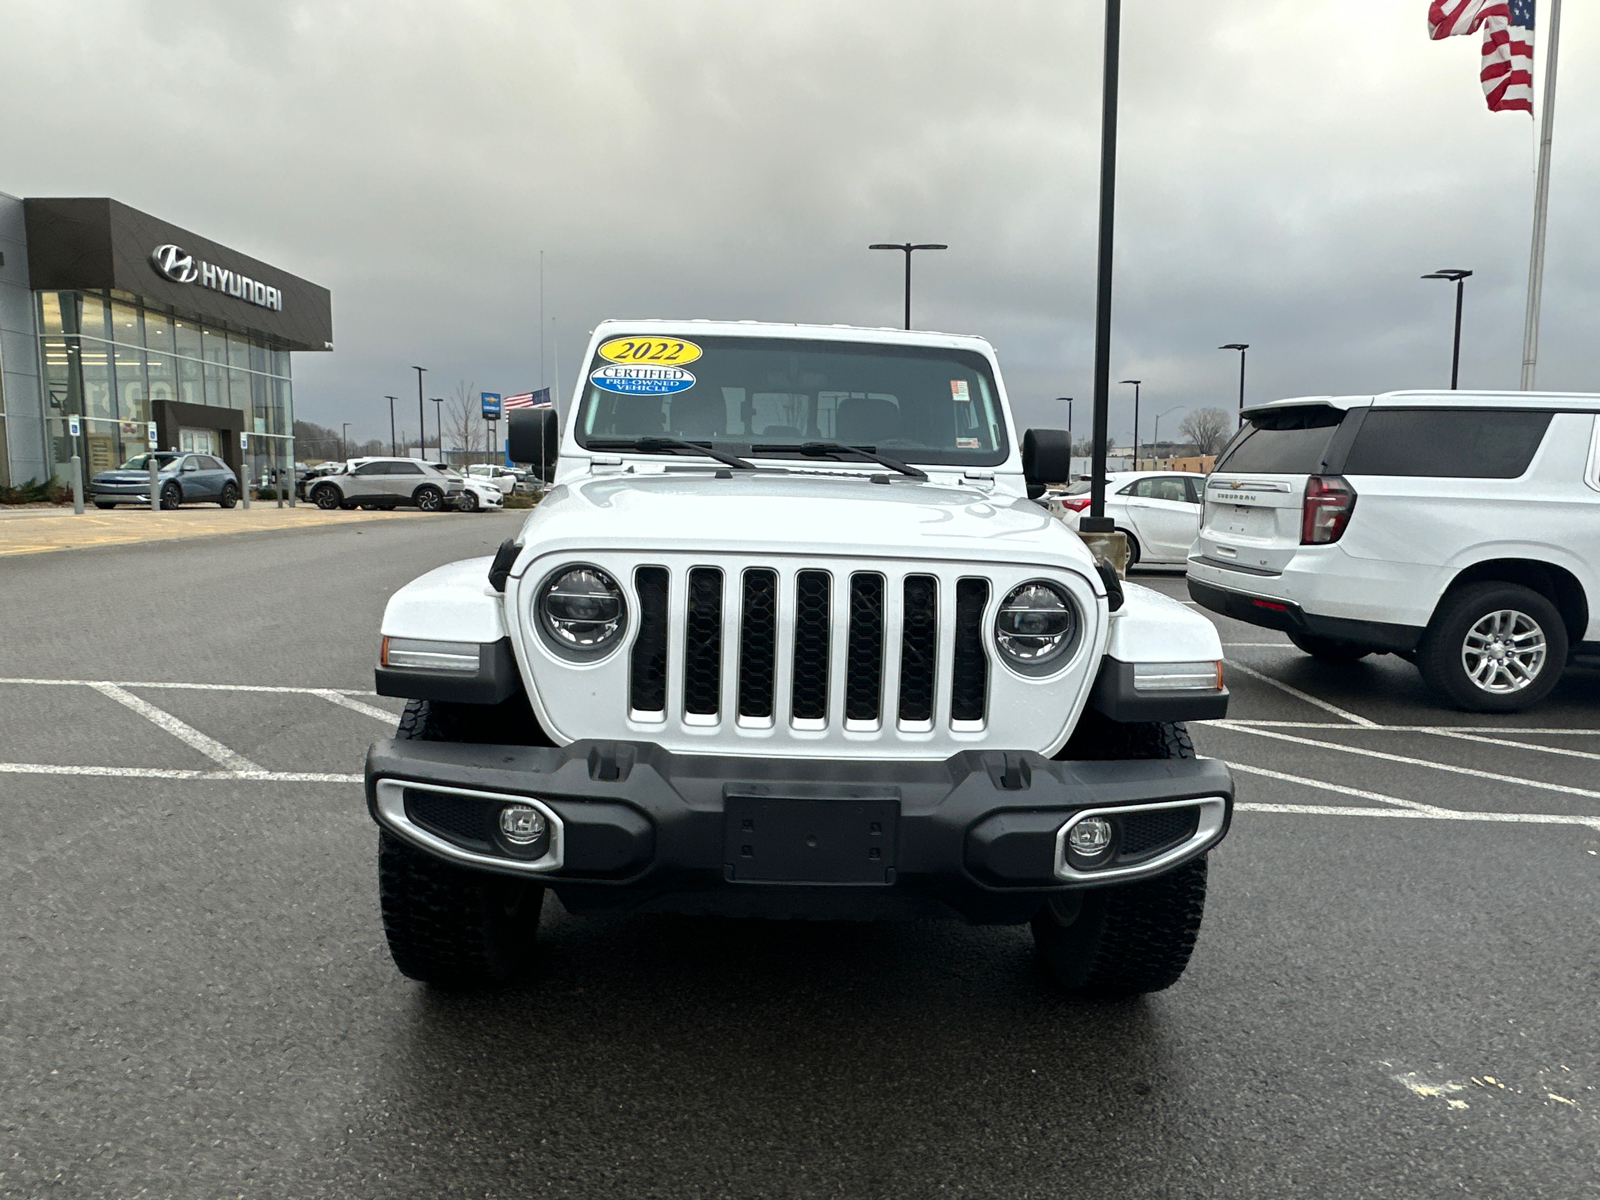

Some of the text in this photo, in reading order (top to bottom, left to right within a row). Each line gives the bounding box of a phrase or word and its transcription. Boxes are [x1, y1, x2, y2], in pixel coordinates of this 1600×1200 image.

[202, 261, 282, 312] HYUNDAI
[614, 342, 684, 361] 2022
[603, 368, 684, 380] CERTIFIED
[605, 379, 680, 387] PRE-OWNED
[616, 384, 669, 392] VEHICLE
